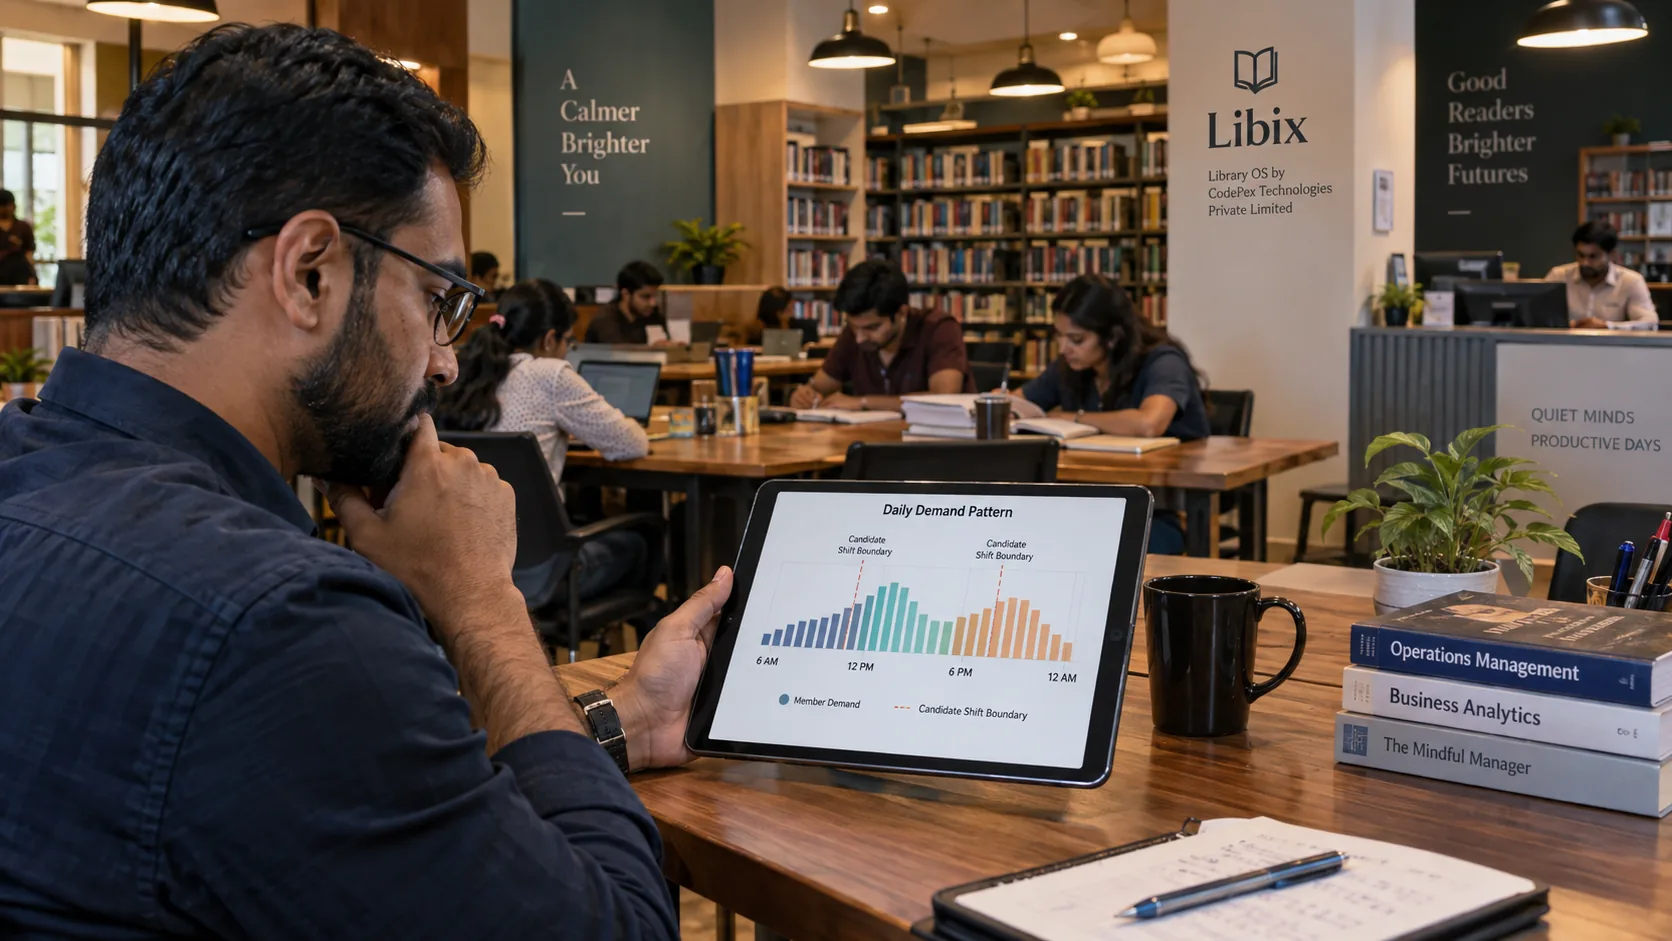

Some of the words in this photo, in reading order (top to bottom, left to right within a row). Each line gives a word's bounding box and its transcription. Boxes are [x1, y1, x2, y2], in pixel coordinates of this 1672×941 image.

[560, 69, 578, 91] A
[1448, 68, 1506, 93] Good
[561, 99, 640, 123] Calmer
[1448, 98, 1534, 123] Readers
[1208, 106, 1308, 148] Libix
[561, 131, 650, 160] Brighter
[1448, 131, 1536, 159] Brighter
[561, 164, 600, 185] You
[1208, 168, 1248, 183] Library
[1251, 168, 1268, 181] OS
[1271, 167, 1285, 181] by
[1448, 164, 1528, 185] Futures
[1208, 186, 1256, 199] CodePex
[1259, 182, 1332, 198] Technologies
[1208, 203, 1246, 216] Private
[1250, 202, 1292, 215] Limited
[1532, 408, 1578, 423] QUIET
[1583, 409, 1634, 424] MINDS
[1531, 434, 1620, 450] PRODUCTIVE
[1624, 437, 1661, 452] DAYS
[883, 504, 913, 518] Daily
[915, 505, 965, 517] Demand
[968, 506, 1013, 518] Pattern
[848, 535, 886, 545] Candidate
[986, 539, 1027, 549] Candidate
[838, 546, 855, 556] Shift
[857, 546, 893, 557] Boundary
[976, 551, 994, 561] Shift
[996, 551, 1033, 563] Boundary
[756, 656, 762, 665] 6
[763, 657, 778, 666] AM
[848, 661, 857, 671] 12
[860, 662, 874, 672] PM
[1390, 641, 1471, 666] Operations
[1476, 652, 1579, 681] Management
[949, 667, 954, 677] 6
[957, 668, 973, 677] PM
[1048, 672, 1058, 682] 12
[1060, 673, 1077, 683] AM
[794, 696, 825, 707] Member
[827, 698, 860, 709] Demand
[1390, 688, 1459, 713] Business
[1463, 699, 1541, 726] Analytics
[919, 704, 962, 717] Candidate
[964, 707, 984, 718] Shift
[986, 709, 1028, 722] Boundary
[1384, 737, 1409, 754] The
[1413, 742, 1464, 763] Mindful
[1470, 751, 1531, 776] Manager
